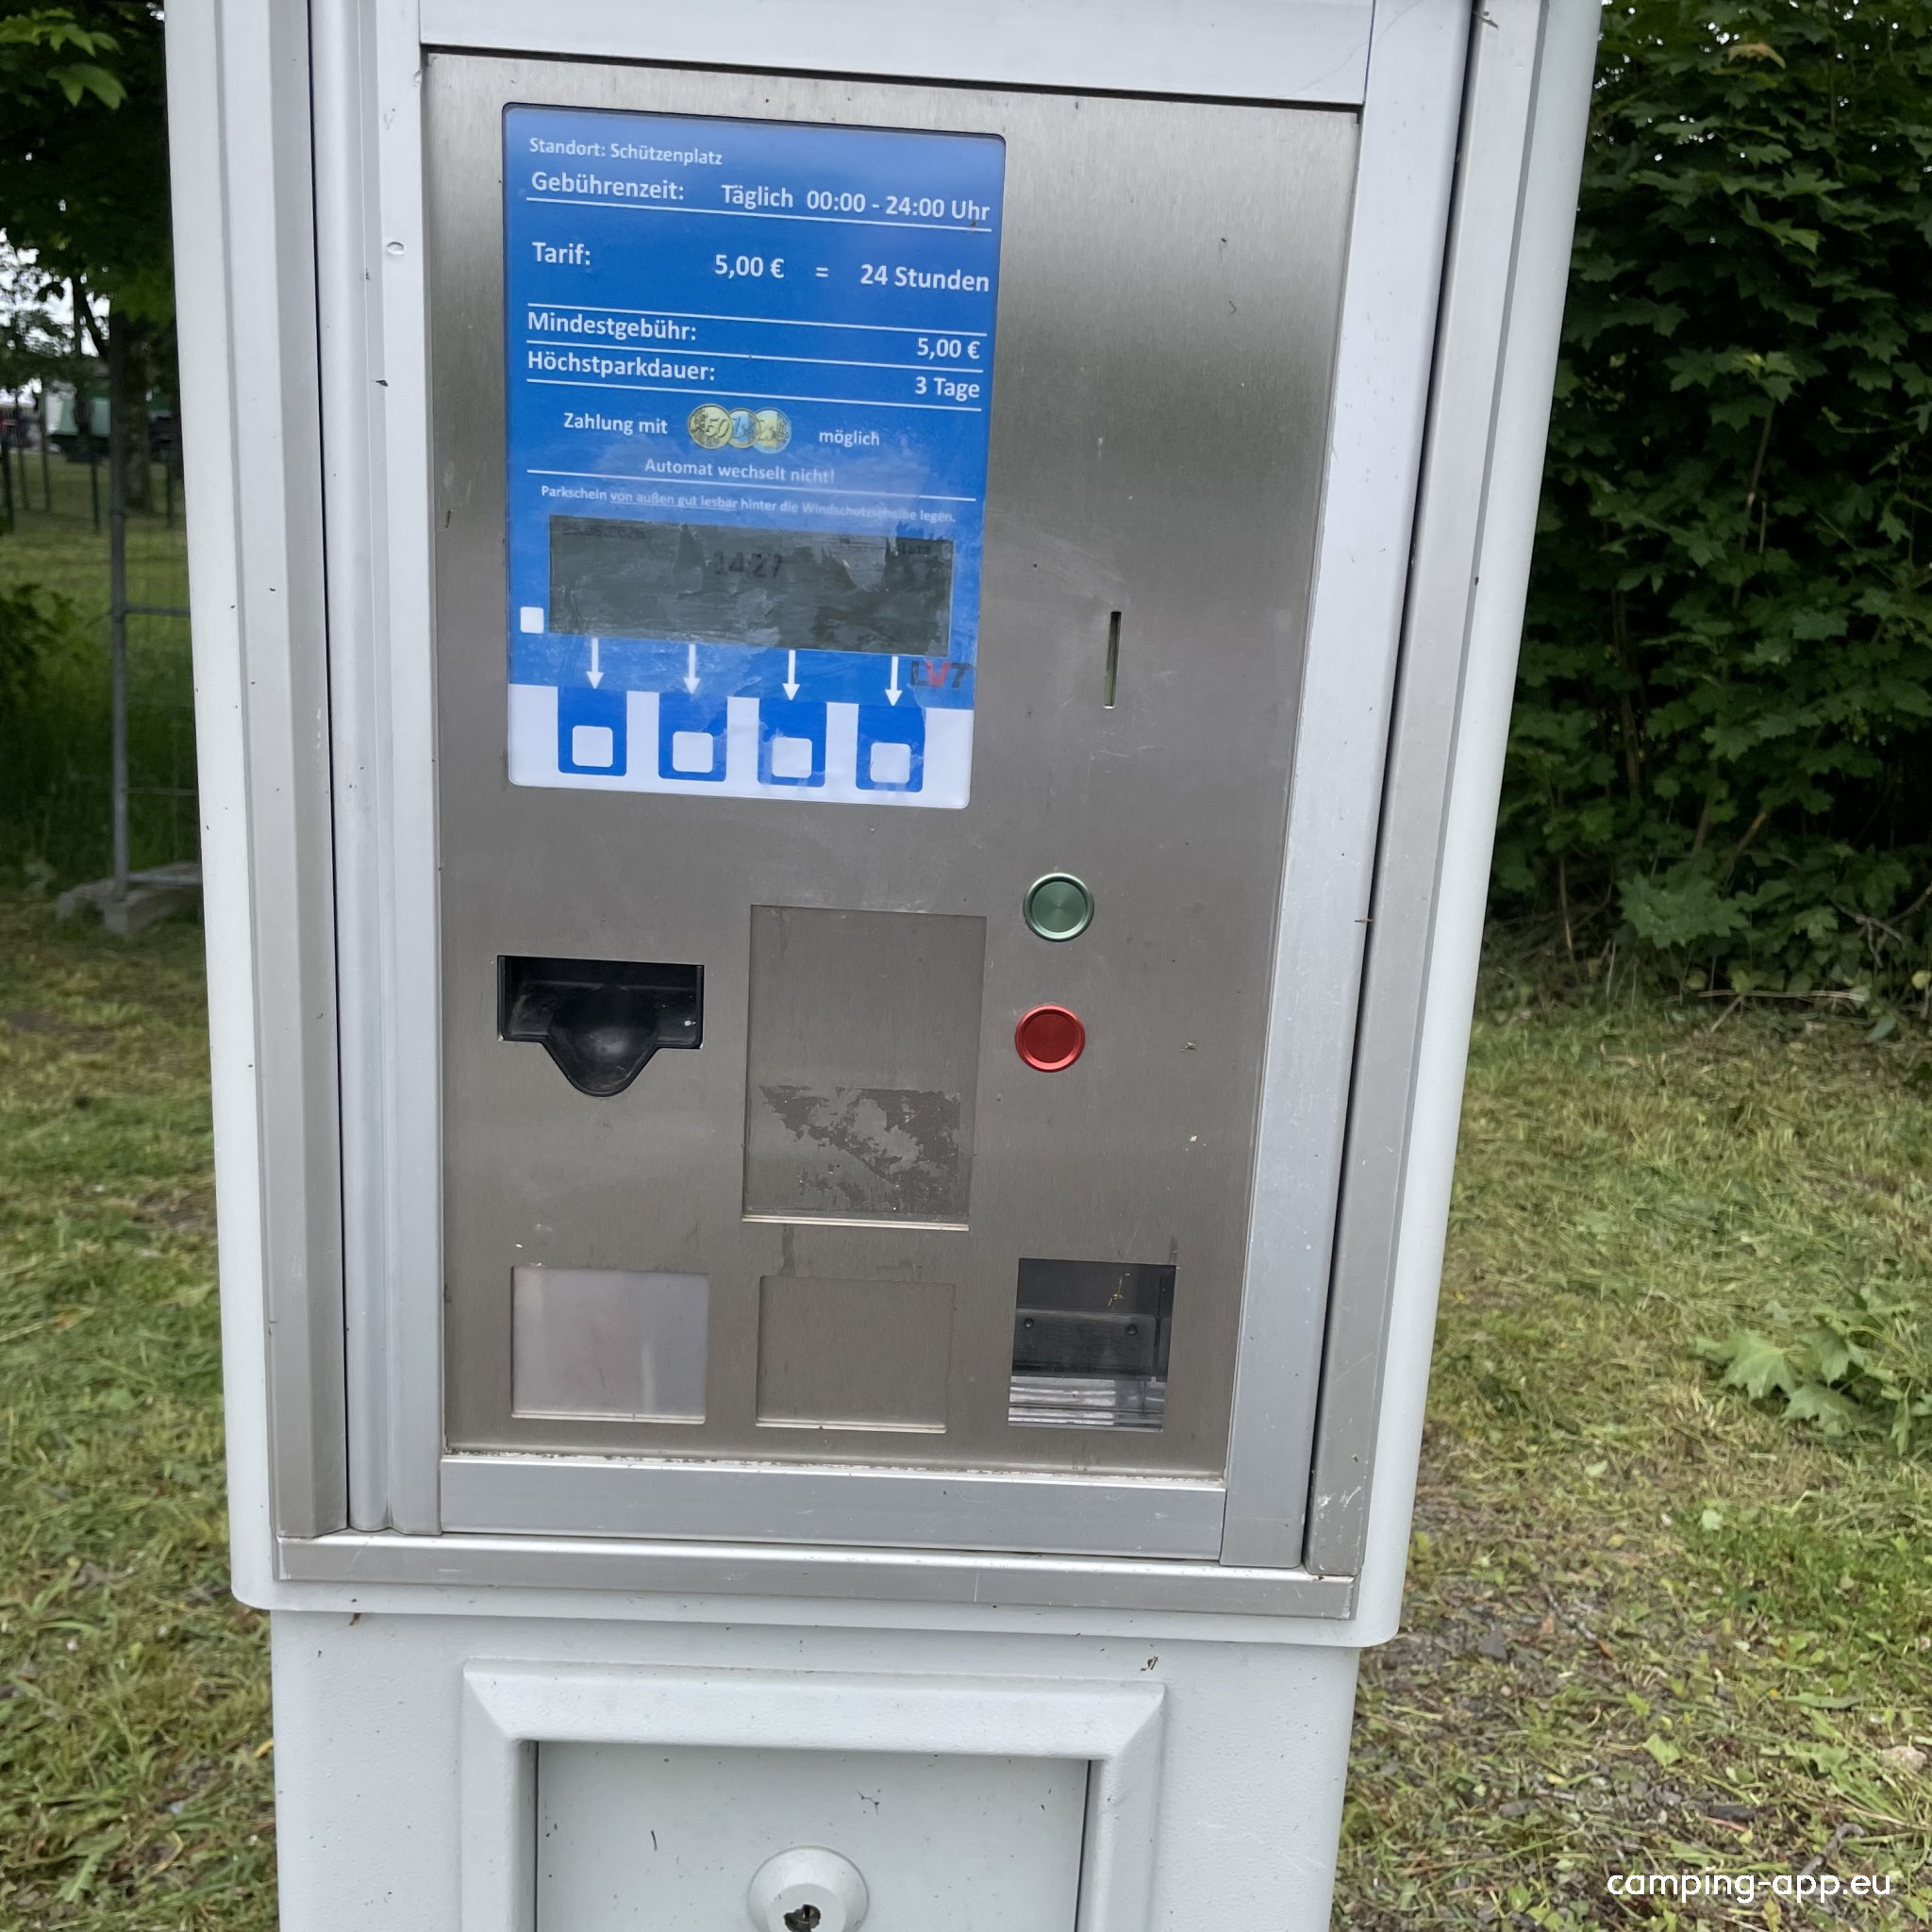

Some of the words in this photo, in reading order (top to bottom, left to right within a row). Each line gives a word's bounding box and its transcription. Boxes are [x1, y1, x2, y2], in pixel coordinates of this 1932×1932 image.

[529, 138, 607, 158] Standort:
[609, 142, 723, 166] Schützenplatz
[531, 171, 685, 201] Gebührenzeit:
[721, 184, 793, 209] Täglich
[806, 190, 866, 213] 00:00
[886, 195, 945, 218] 24:00
[950, 199, 990, 221] Uhr
[532, 241, 591, 266] Tarif:
[714, 255, 764, 280] 5,00
[770, 258, 785, 278] €
[815, 265, 829, 278] =
[860, 263, 888, 286] 24
[894, 266, 990, 292] Stunden
[527, 312, 697, 341] Mindestgebühr:
[917, 337, 963, 359] 5,00
[966, 341, 980, 359] €
[527, 350, 715, 381] Höchstparkdauer:
[915, 376, 927, 395] 3
[933, 377, 980, 402] Tage
[563, 412, 633, 436] Zahlung
[638, 418, 668, 435] mit
[819, 428, 880, 448] möglich
[644, 458, 714, 476] Automat
[717, 462, 787, 480] wechselt
[790, 467, 835, 483] nicht!
[541, 485, 608, 501] Parkschein
[610, 491, 634, 502] von
[636, 491, 675, 505] außen
[677, 494, 697, 508] gut
[701, 494, 739, 508] lesbar
[741, 498, 777, 512] hinter
[780, 501, 798, 513] die
[920, 509, 956, 524] legen.
